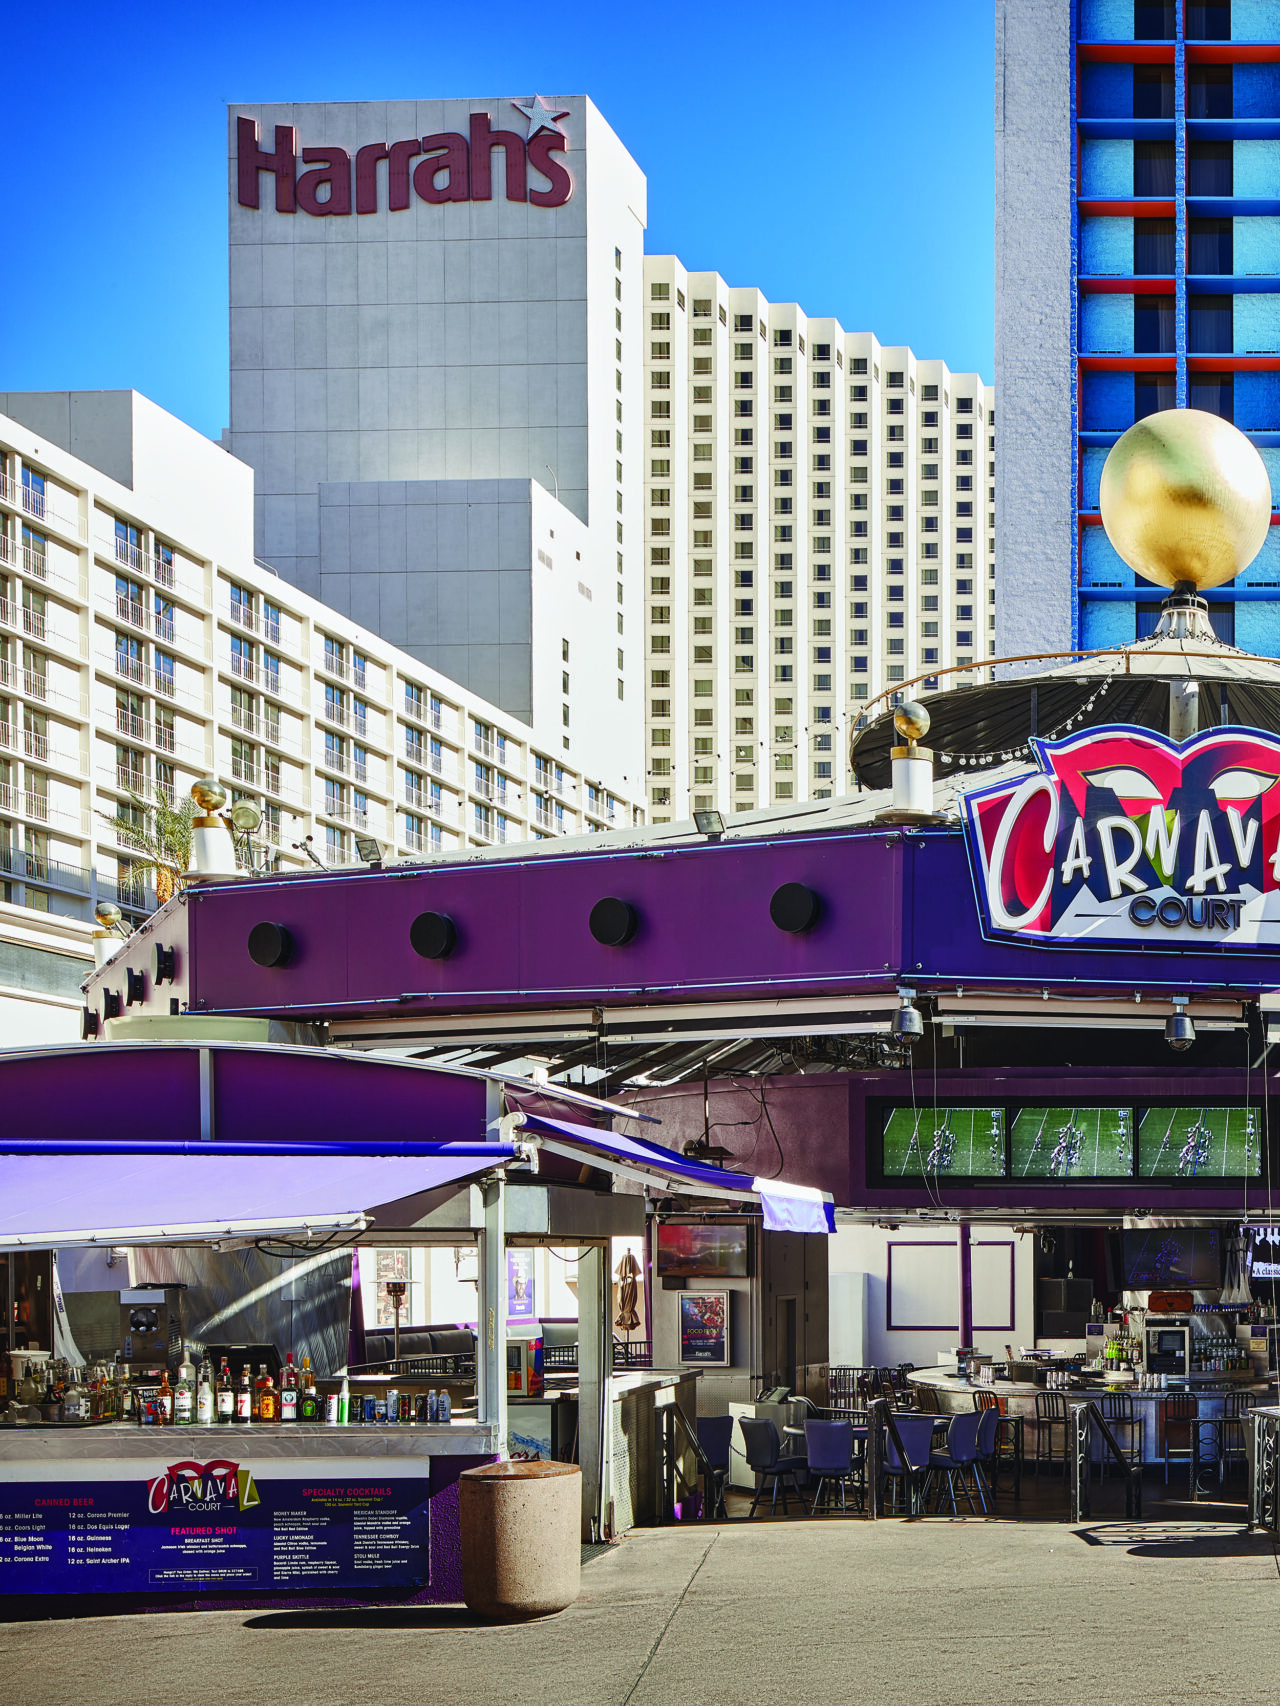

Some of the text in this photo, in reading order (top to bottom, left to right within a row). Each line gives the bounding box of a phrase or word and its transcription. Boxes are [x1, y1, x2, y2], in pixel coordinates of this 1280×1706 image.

[1129, 895, 1246, 929] COURT
[1262, 1267, 1280, 1275] classic
[302, 1488, 344, 1496] SPECIALTY
[73, 1498, 94, 1506] BEER
[188, 1503, 221, 1511] COURT
[171, 1526, 237, 1535] FEATURED SHOT
